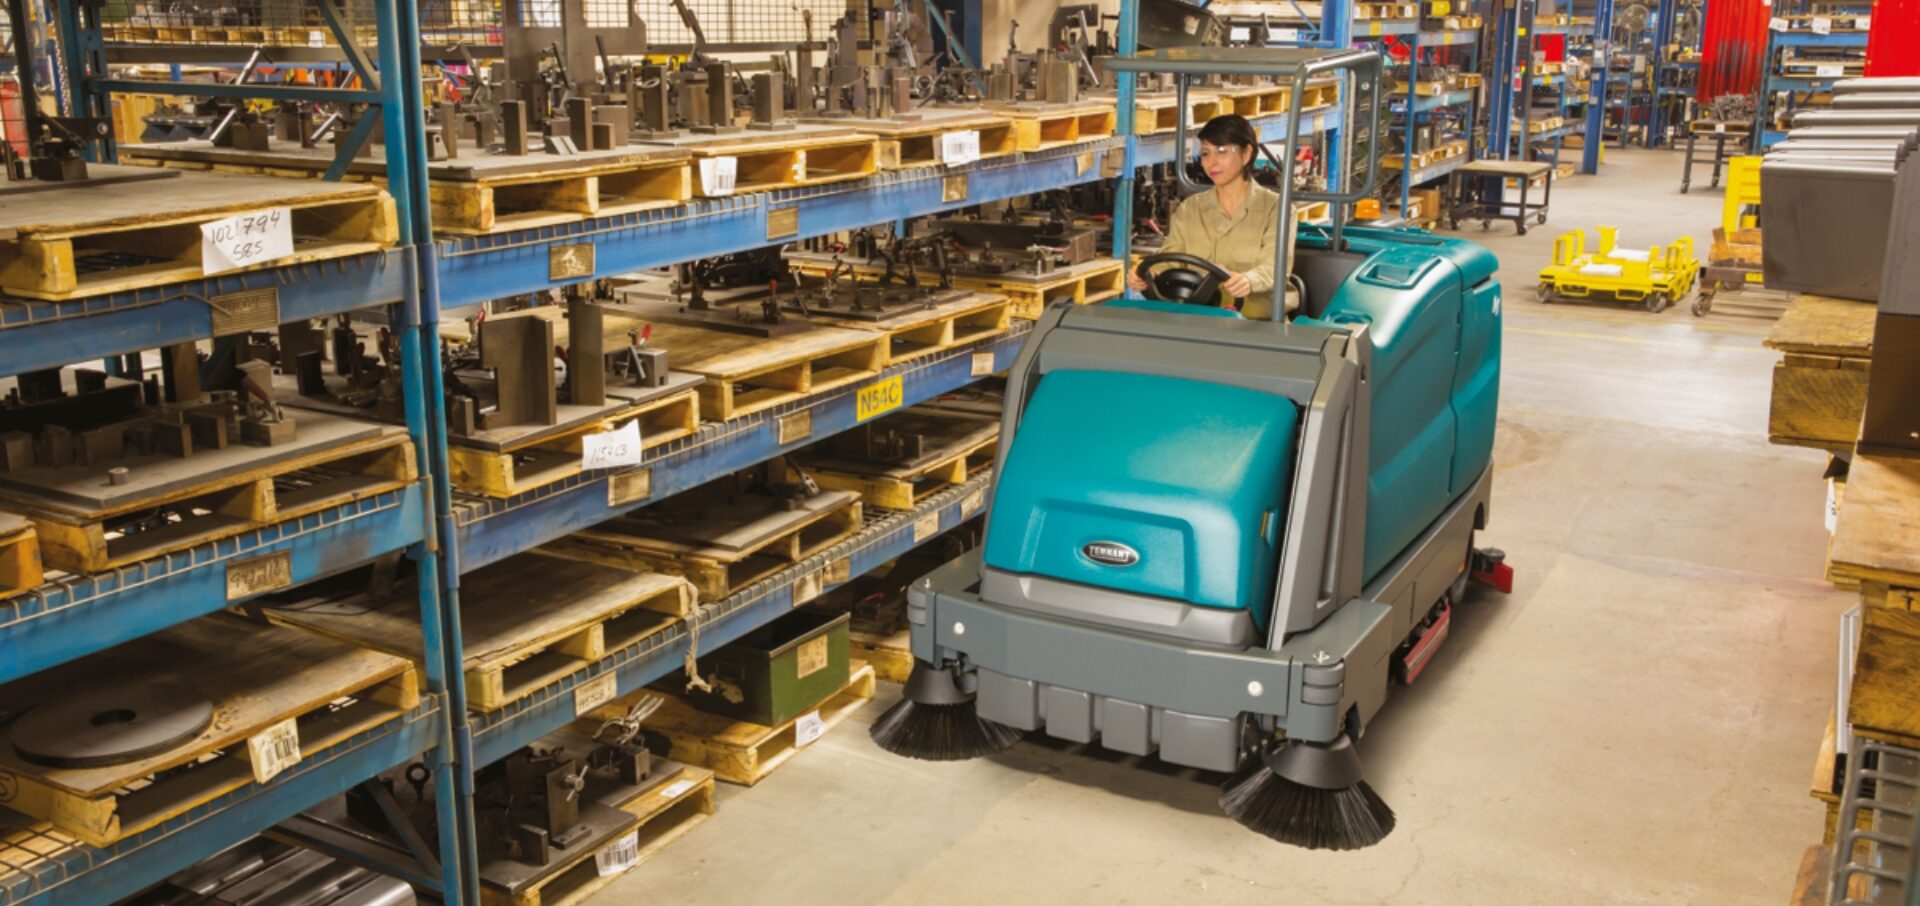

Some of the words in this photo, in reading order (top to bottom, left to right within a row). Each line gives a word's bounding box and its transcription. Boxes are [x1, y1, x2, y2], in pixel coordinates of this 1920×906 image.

[211, 210, 281, 244] 1021794
[861, 382, 898, 415] N54C
[1089, 545, 1130, 562] TENNANT
